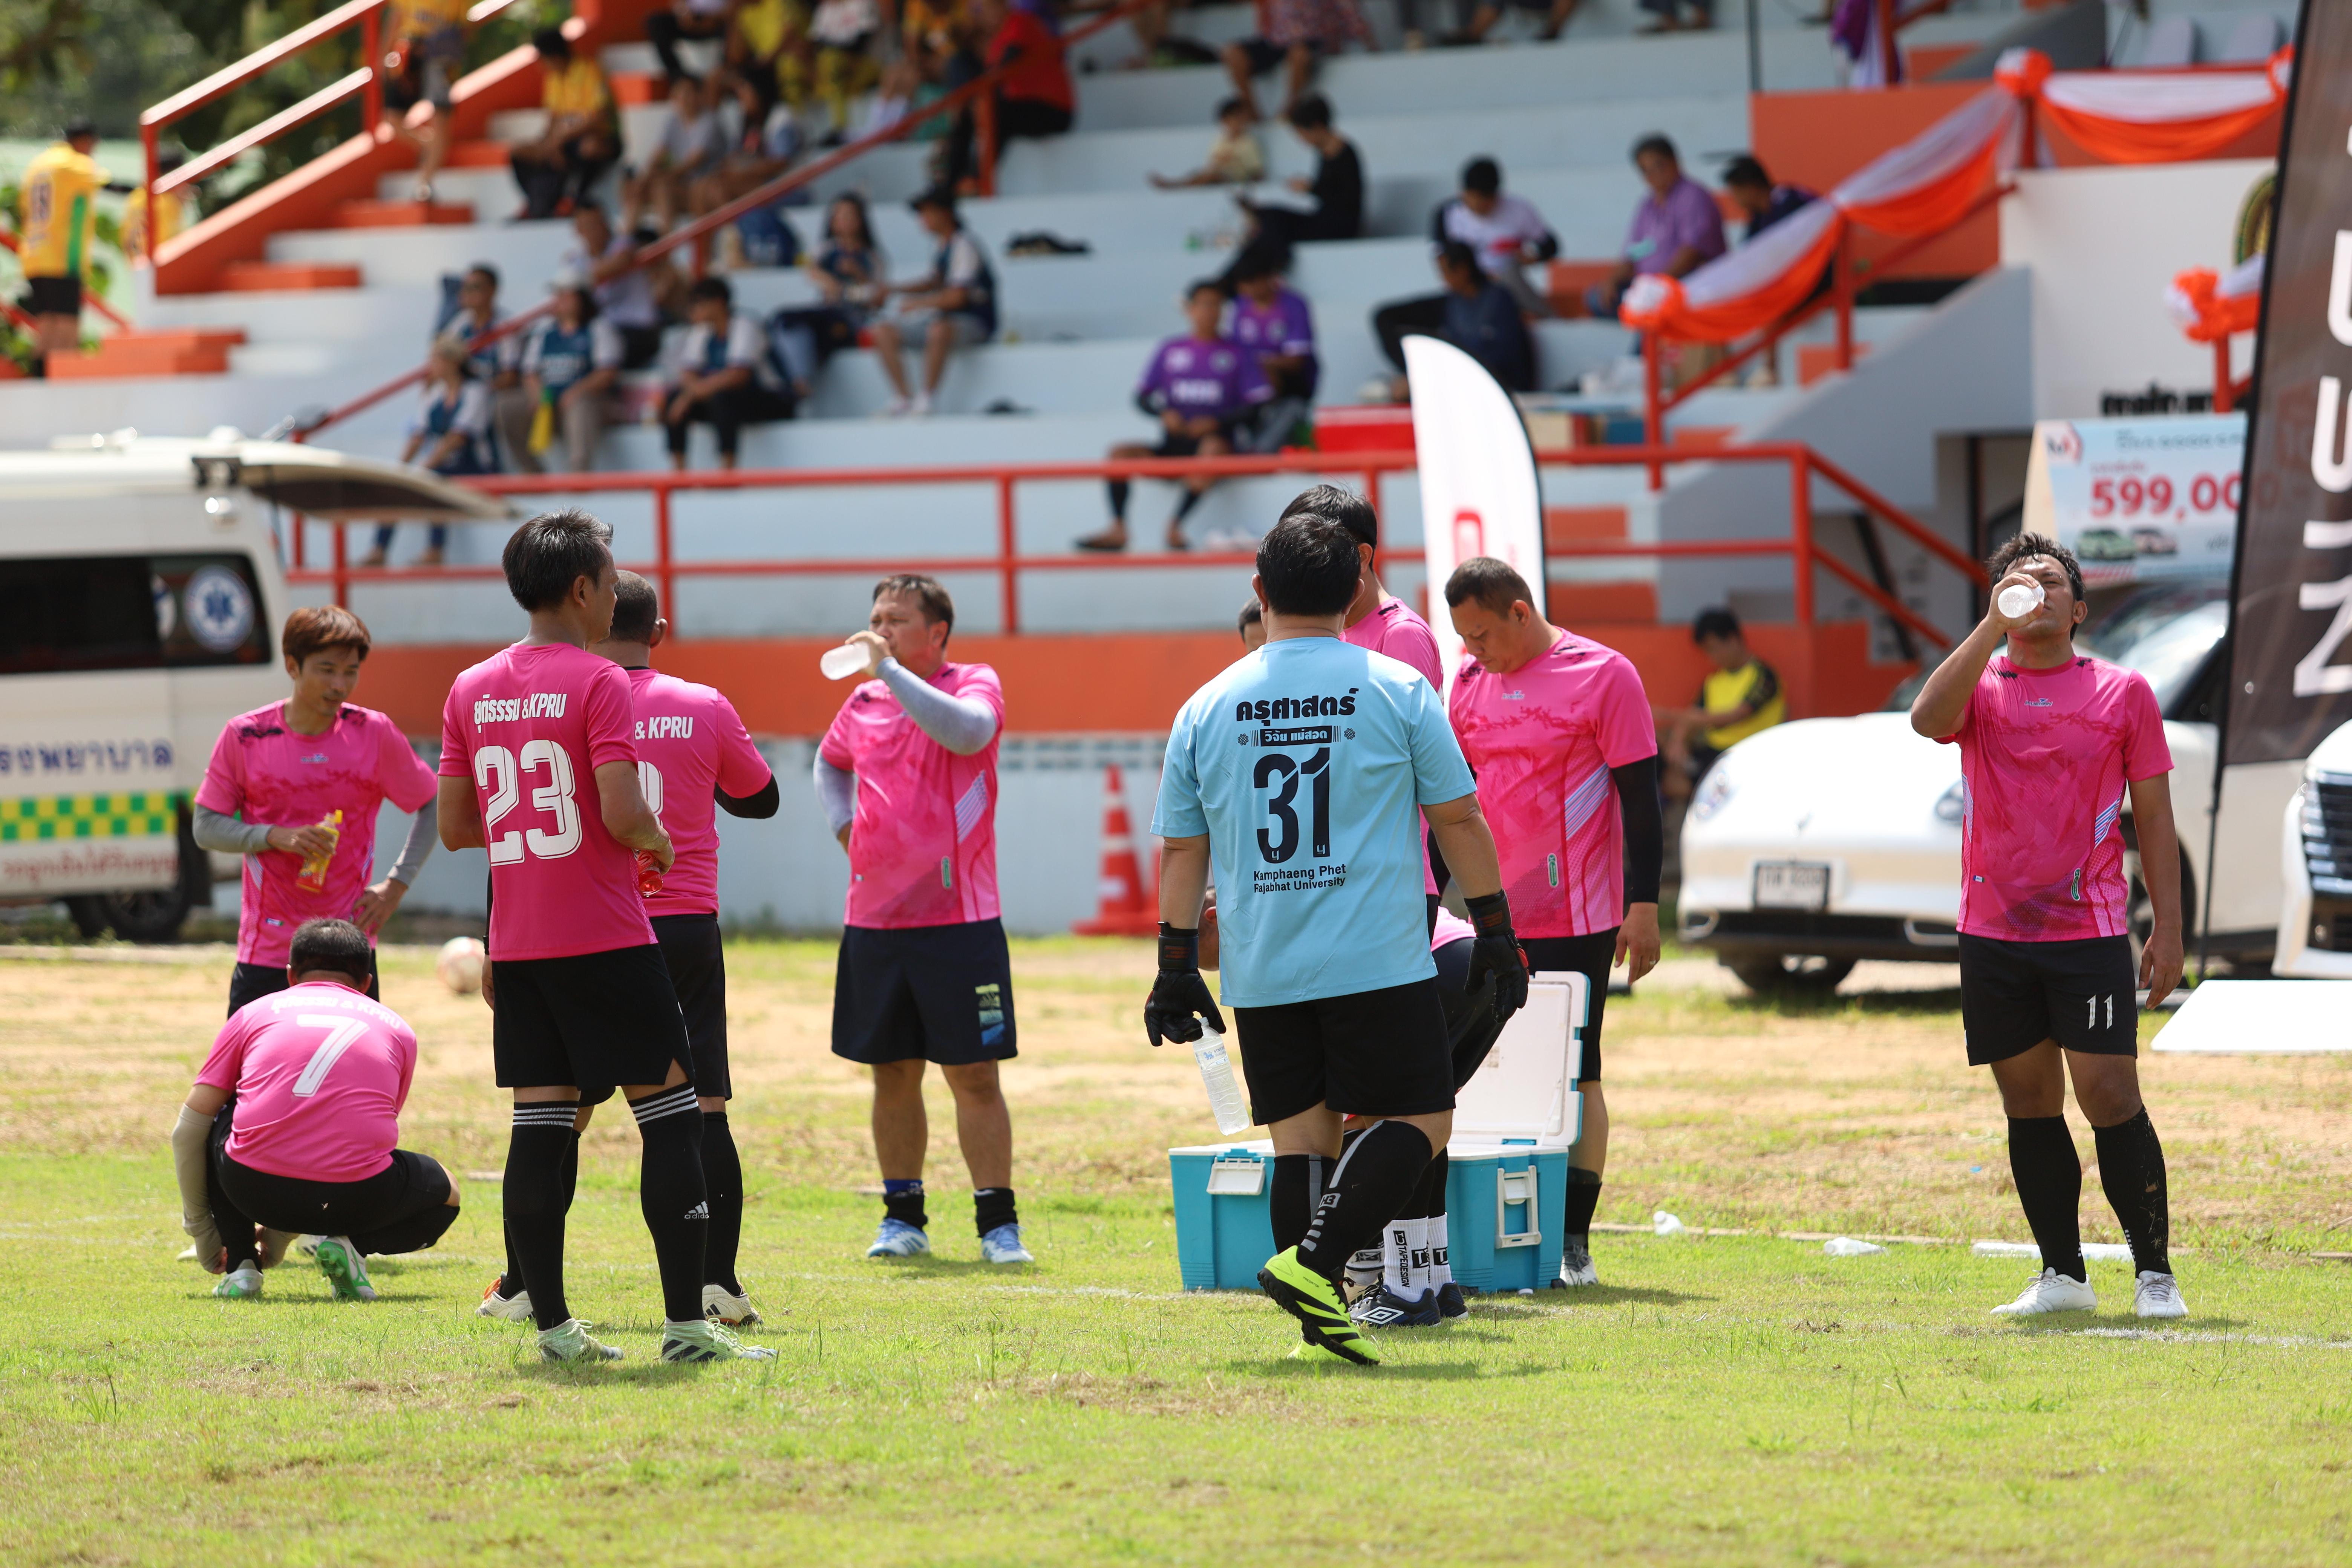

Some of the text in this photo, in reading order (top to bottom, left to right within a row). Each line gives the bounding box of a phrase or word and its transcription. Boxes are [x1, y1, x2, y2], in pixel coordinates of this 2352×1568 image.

[1236, 688, 1359, 726] ครุศาสตร์
[648, 716, 694, 739] KPRU
[1264, 729, 1328, 742] วิจัย แม่สอด
[475, 740, 583, 867] 23
[1254, 747, 1330, 864] 31
[1254, 864, 1346, 882] Kamphaeng Phet
[1254, 877, 1346, 894] Rajabhat University
[340, 1000, 354, 1009] &
[357, 1002, 401, 1030] KPRU
[2087, 994, 2113, 1030] 11
[292, 1014, 370, 1097] 7
[1398, 1246, 1410, 1288] TAPEDESIGN
